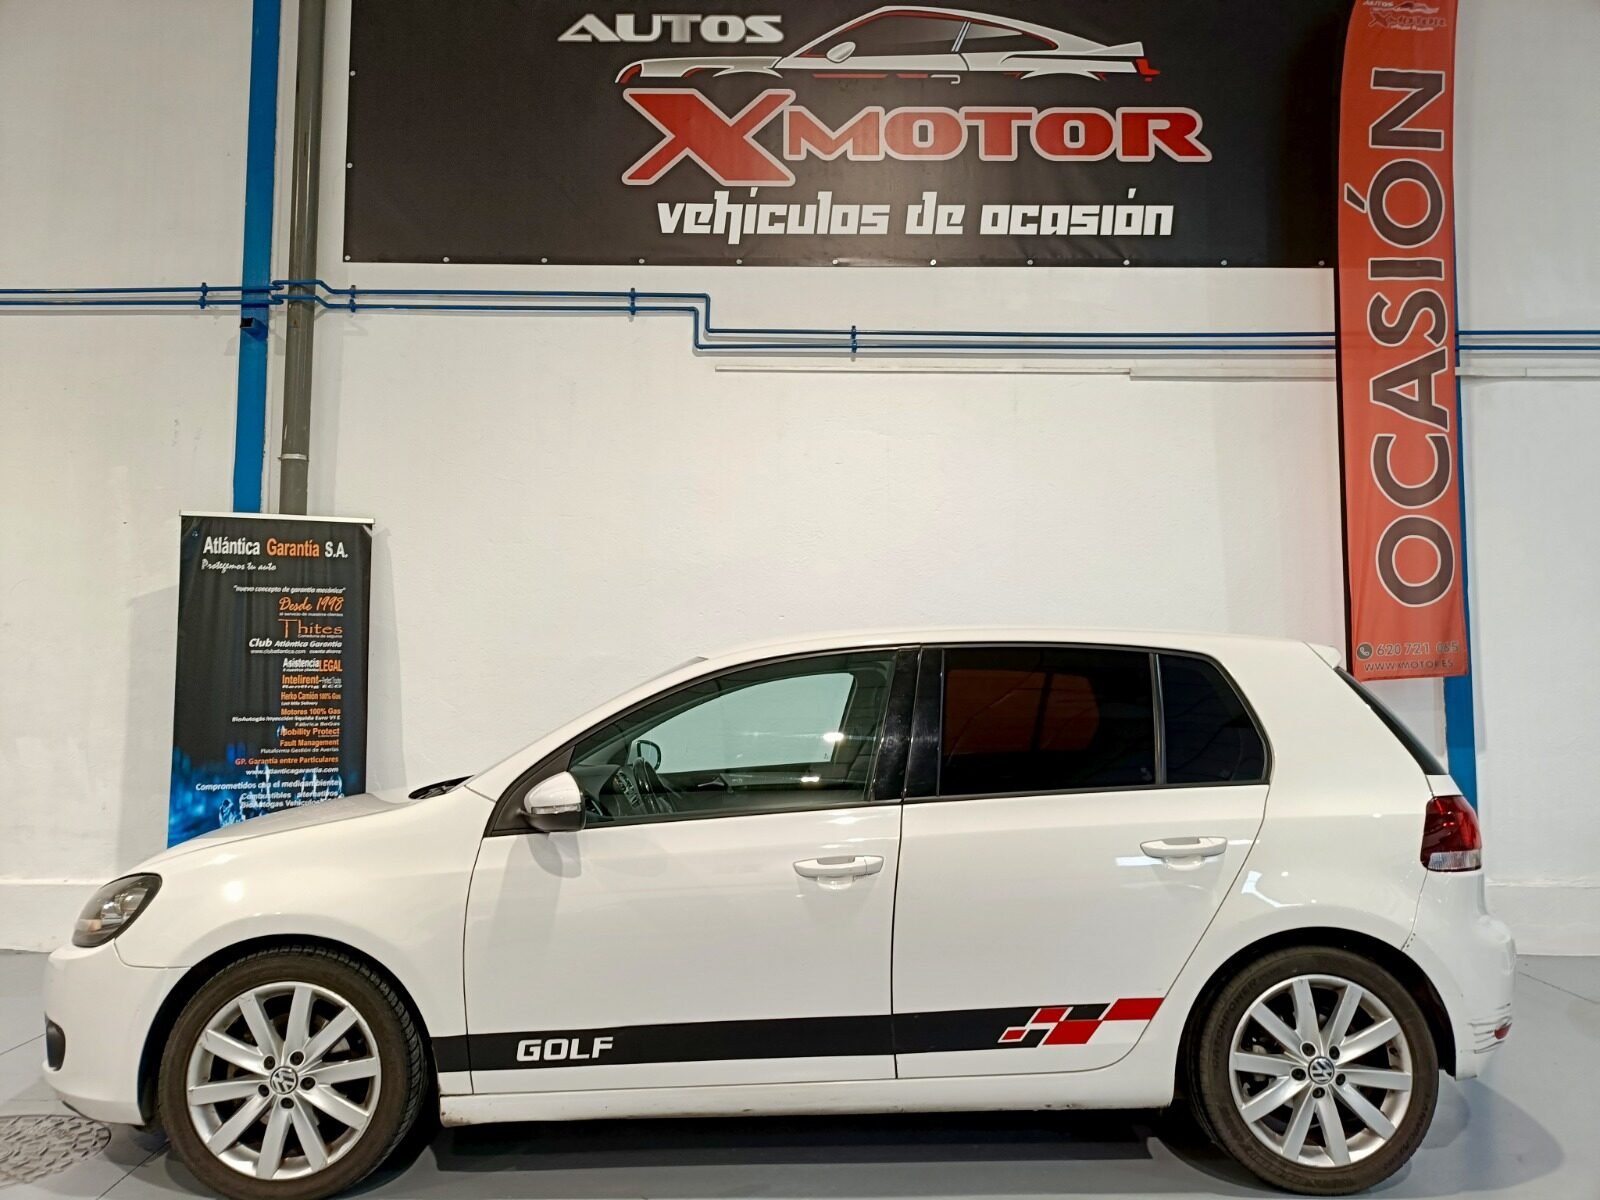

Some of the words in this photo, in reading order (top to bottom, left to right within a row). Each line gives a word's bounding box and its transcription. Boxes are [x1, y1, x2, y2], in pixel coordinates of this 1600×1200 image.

[558, 13, 785, 44] AUTOS
[621, 88, 1212, 187] XMOTOR
[657, 187, 890, 244] vehículos
[904, 191, 966, 236] de
[980, 188, 1174, 236] ocasión
[1343, 66, 1455, 608] OCASIÓN
[203, 536, 260, 555] Atlántica
[266, 538, 320, 557] Garantía
[324, 541, 348, 558] S.A.
[279, 596, 312, 611] Desde
[316, 595, 345, 612] 1998
[278, 619, 343, 639] Thites
[248, 638, 272, 647] Club
[1376, 643, 1401, 656] 620
[1403, 642, 1431, 656] 721
[298, 739, 339, 747] Management
[195, 780, 256, 791] Comprometidos
[516, 1036, 613, 1062] GOLF
